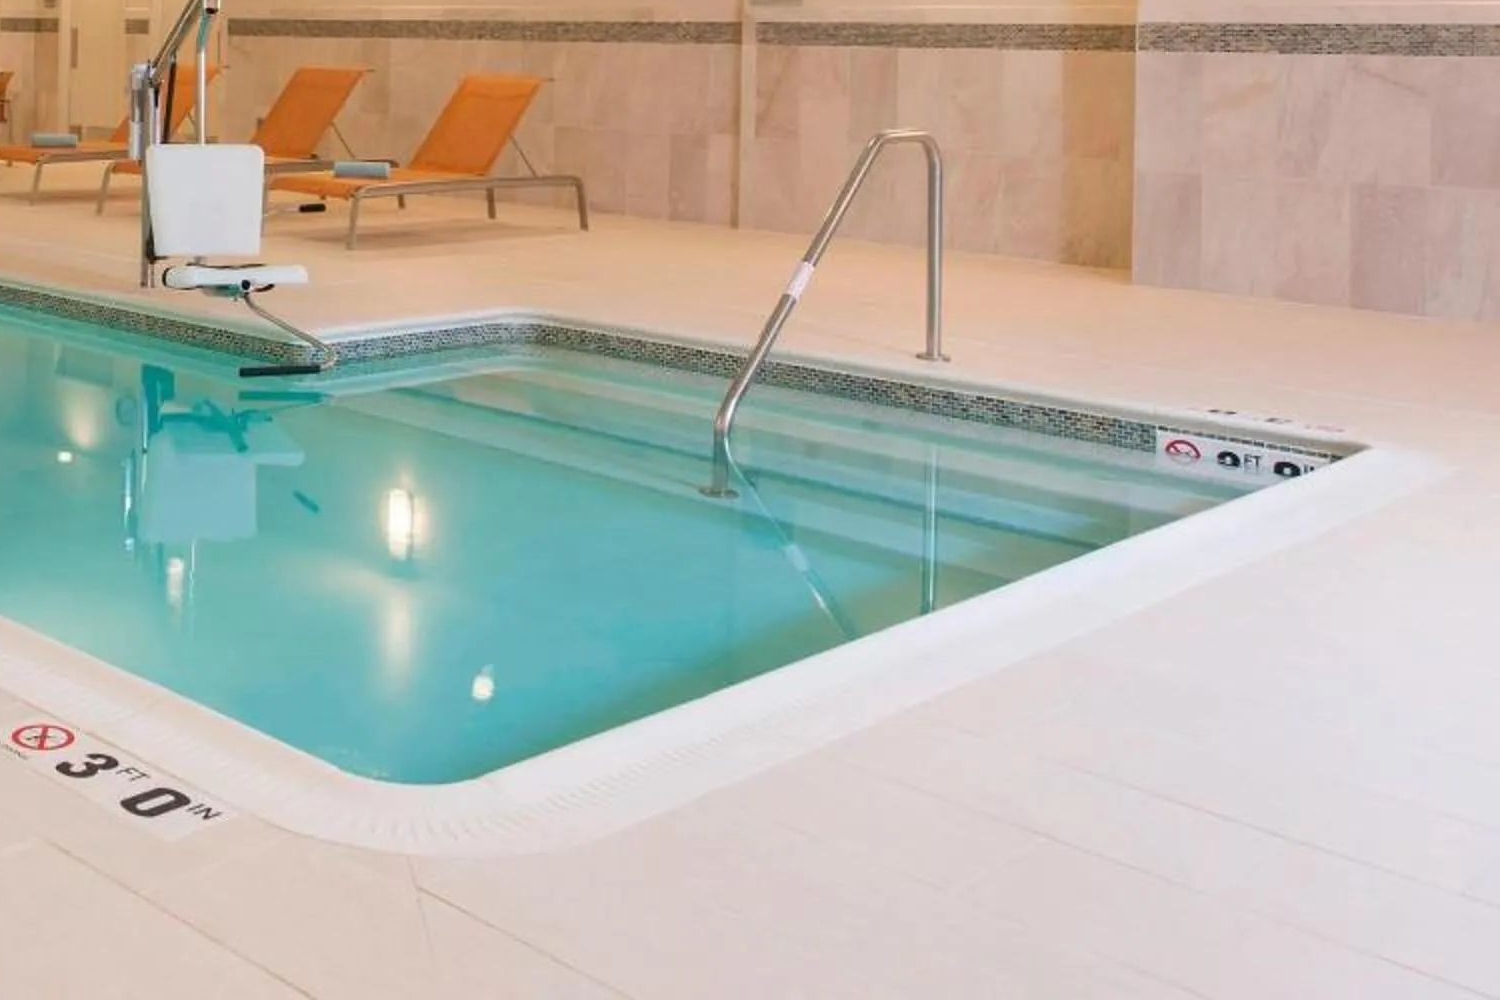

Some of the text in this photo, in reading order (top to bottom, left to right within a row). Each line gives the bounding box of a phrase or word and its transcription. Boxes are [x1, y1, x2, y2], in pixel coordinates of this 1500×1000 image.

[56, 753, 221, 820] 3 FT 0 IN
